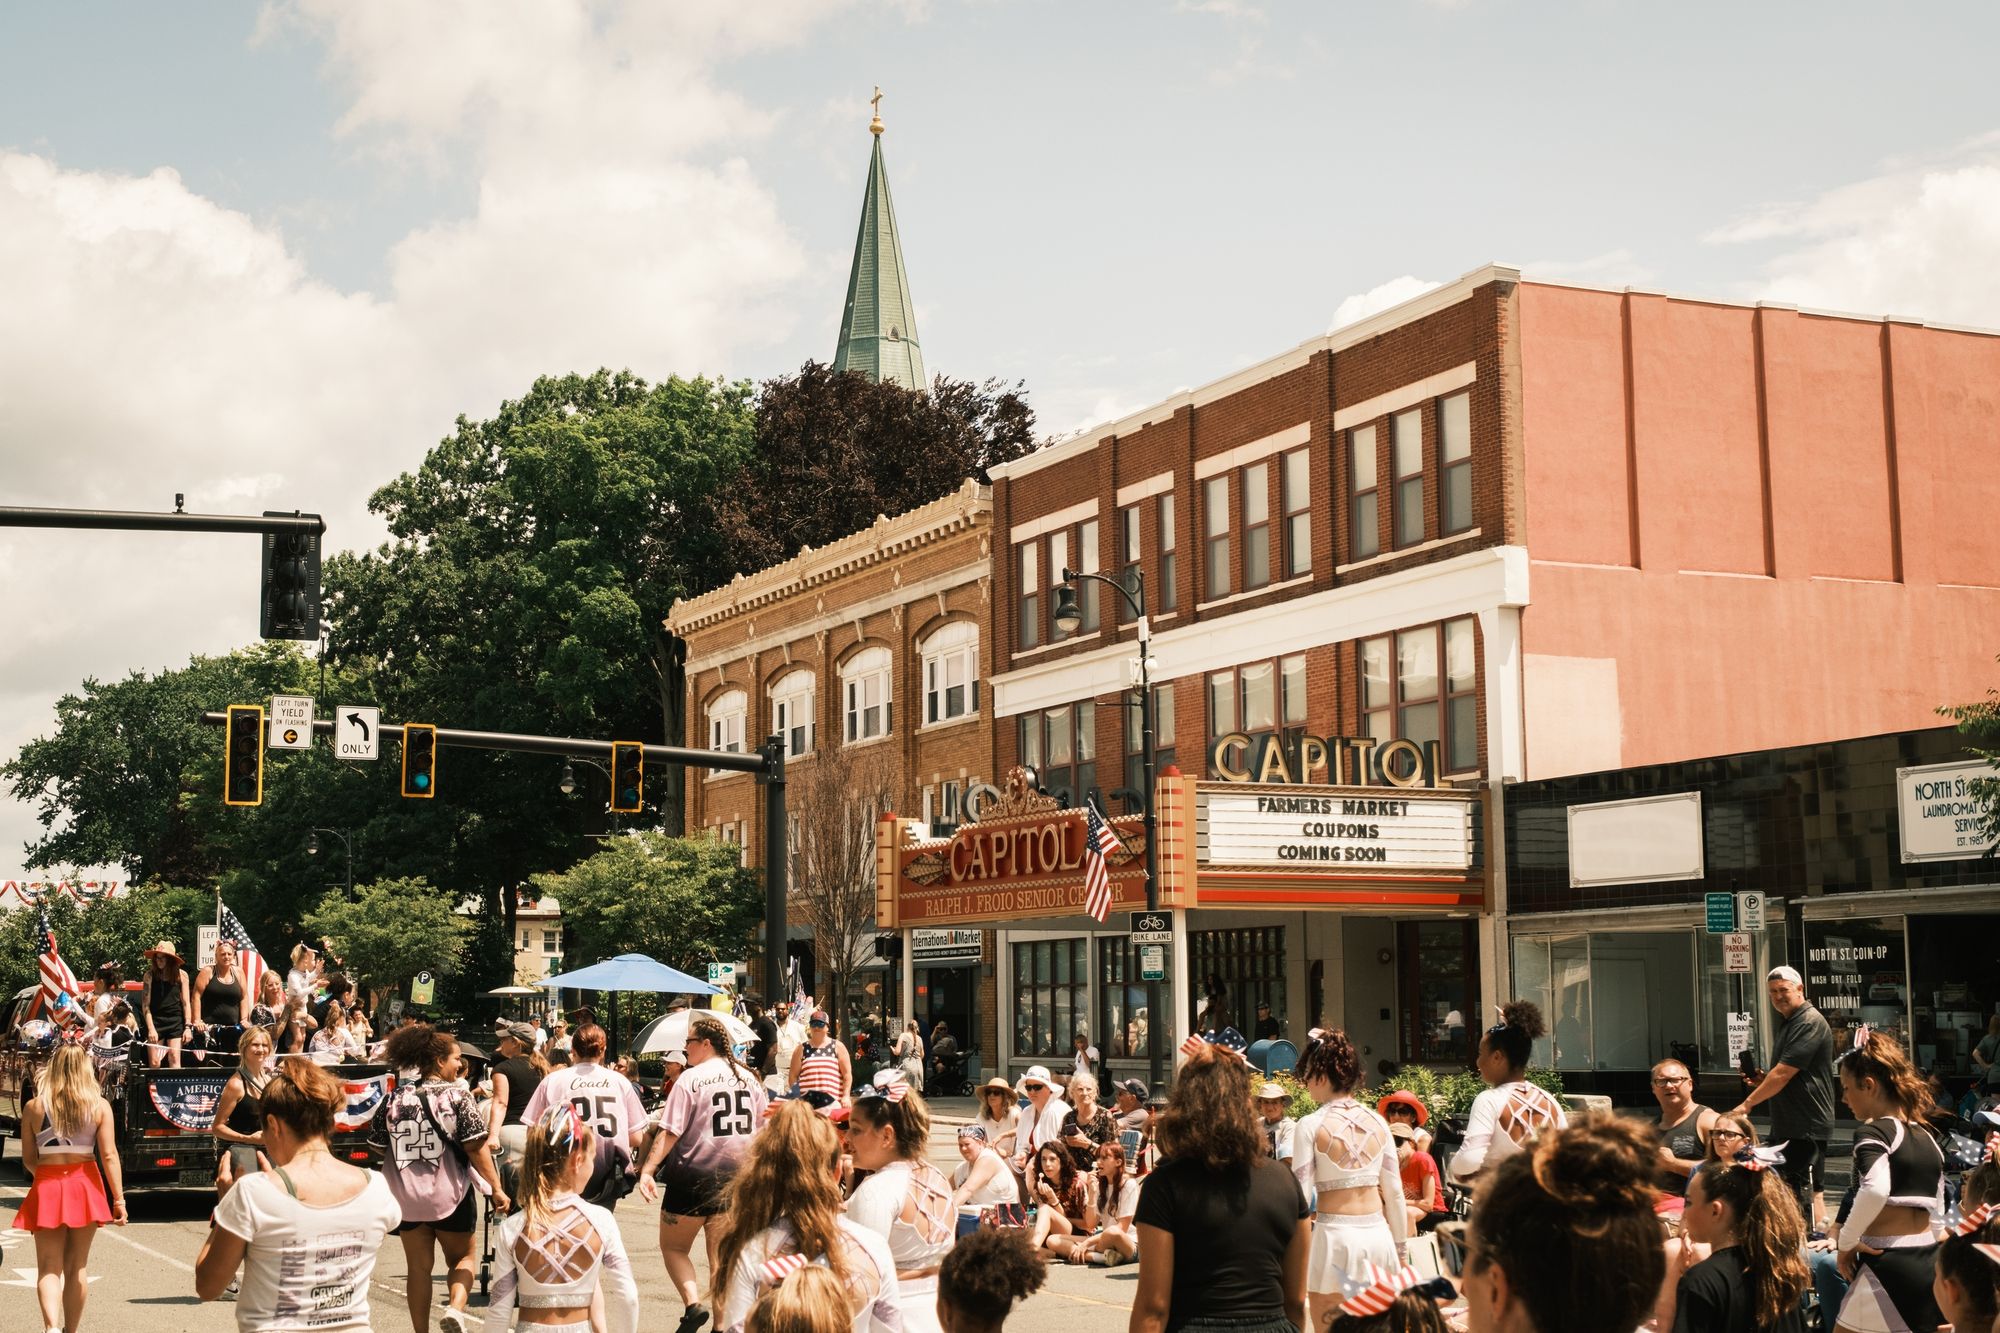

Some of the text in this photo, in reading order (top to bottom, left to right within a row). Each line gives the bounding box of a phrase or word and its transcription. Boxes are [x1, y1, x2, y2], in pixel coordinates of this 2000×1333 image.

[281, 708, 304, 717] YIELD
[342, 743, 371, 754] ONLY
[1208, 731, 1453, 788] CAPITOL
[1915, 780, 1952, 800] NORTH
[1257, 797, 1410, 817] FARMERS MARKET
[1922, 801, 1977, 818] LAUNDROMAT
[1302, 822, 1380, 839] COUPONS
[951, 822, 1084, 882] CAPITOL
[1277, 844, 1386, 862] COMING SOON
[926, 881, 1124, 917] RALPH J. FROIO SENIOR CEER
[912, 930, 980, 947] nternational Market
[1810, 948, 1837, 961] NORTH
[1811, 975, 1827, 984] WASH
[1819, 996, 1860, 1009] LAUNDROMAT
[570, 1077, 610, 1090] Coach
[692, 1073, 724, 1092] Coach
[711, 1090, 752, 1137] 25
[396, 1119, 443, 1161] 23
